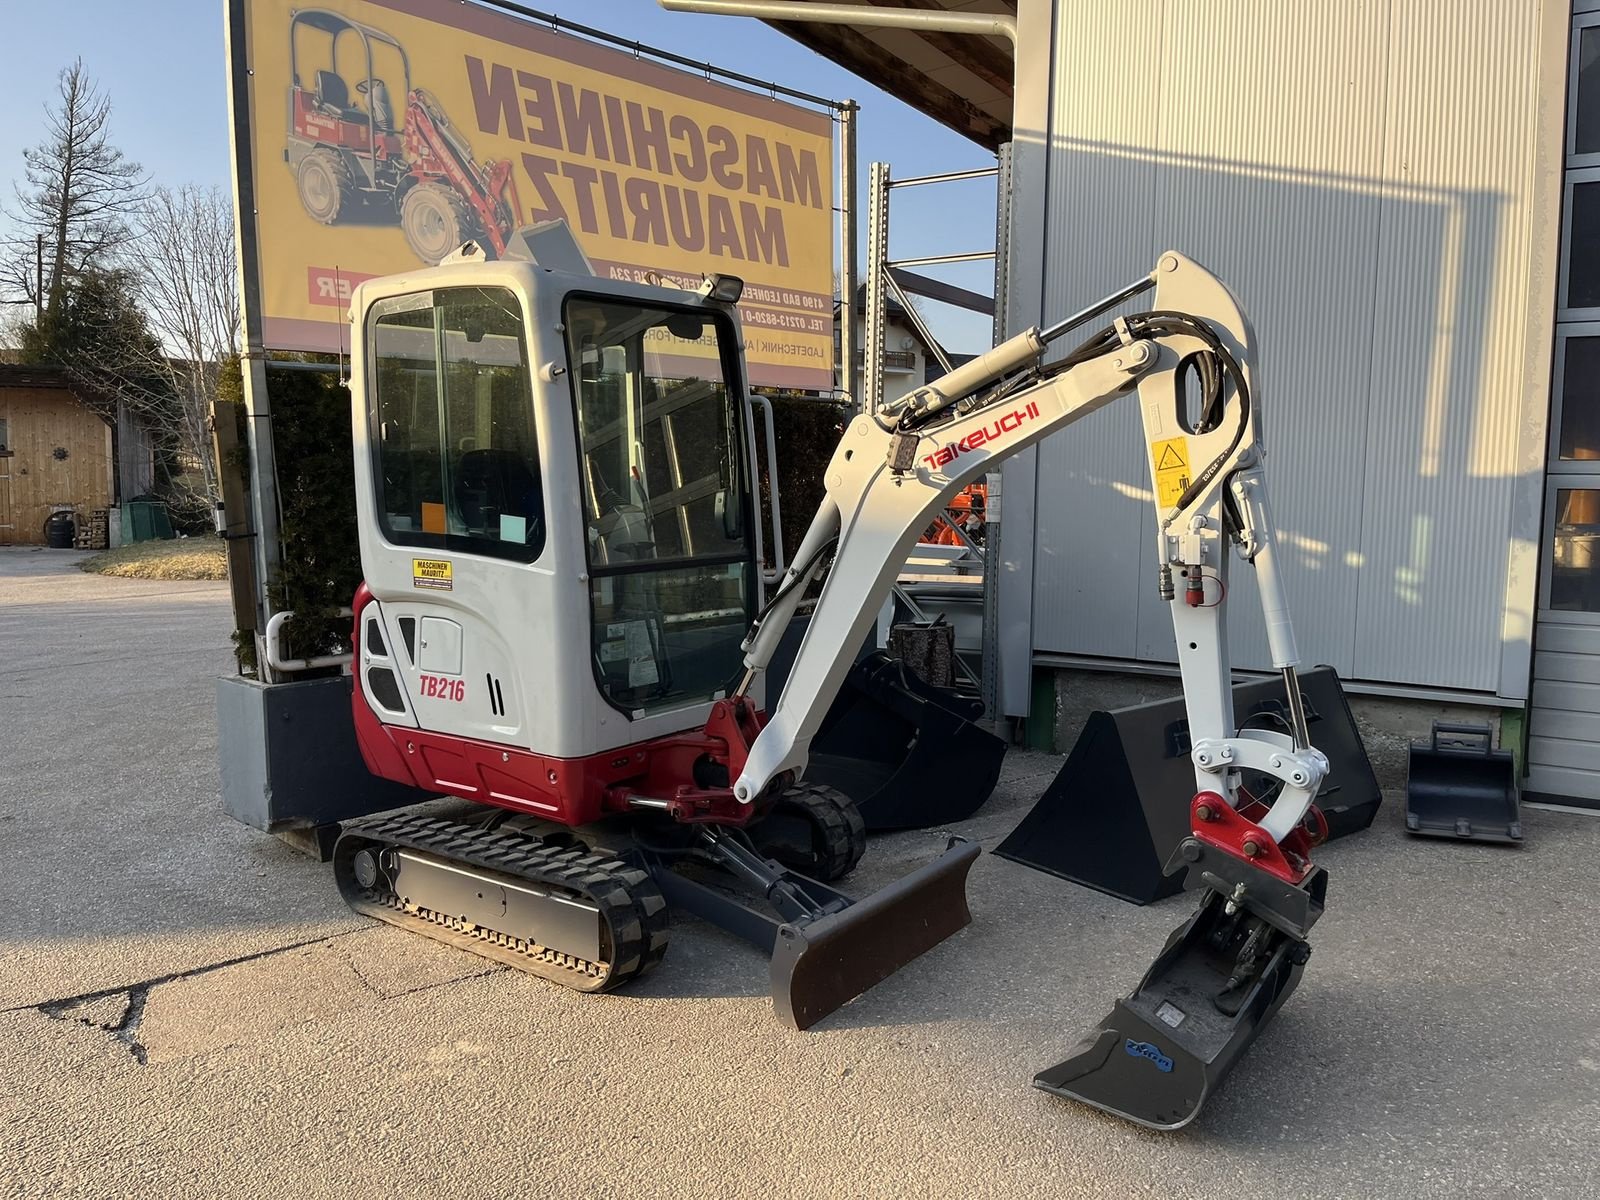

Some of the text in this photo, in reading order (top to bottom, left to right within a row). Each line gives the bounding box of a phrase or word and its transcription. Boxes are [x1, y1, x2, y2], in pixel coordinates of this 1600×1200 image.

[417, 560, 448, 571] MASCHINEN
[421, 568, 445, 578] MAURITZ
[419, 674, 465, 702] TB216
